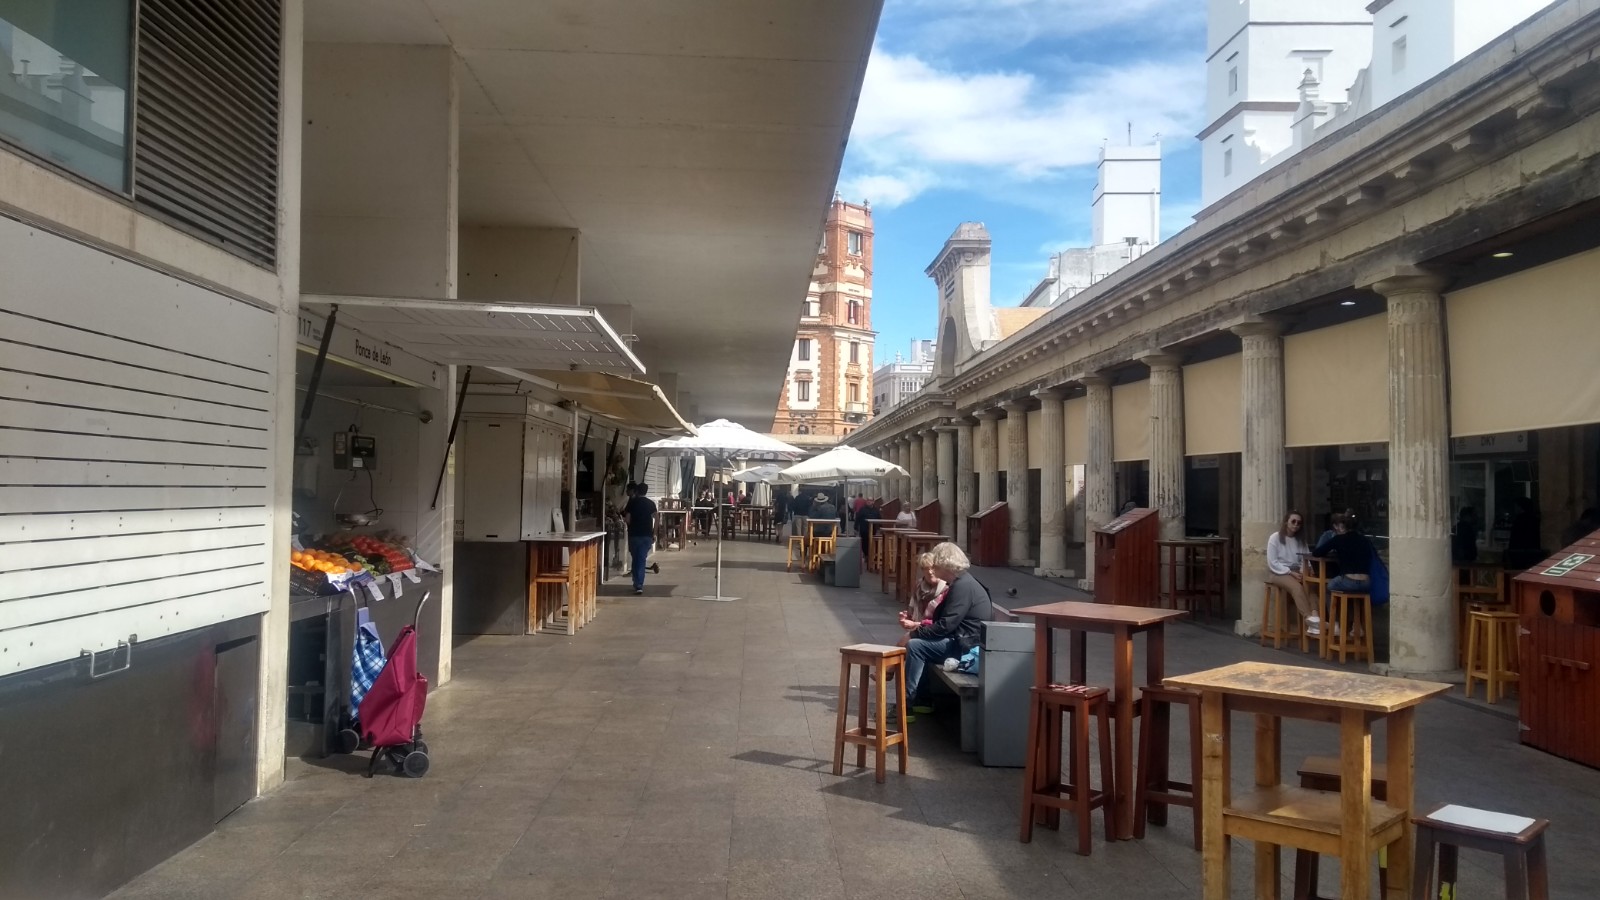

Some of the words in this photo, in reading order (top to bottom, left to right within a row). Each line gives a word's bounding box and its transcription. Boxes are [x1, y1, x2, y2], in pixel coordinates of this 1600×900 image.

[298, 317, 312, 337] 117
[355, 338, 371, 359] Ponce
[372, 345, 379, 363] de
[380, 347, 392, 367] León
